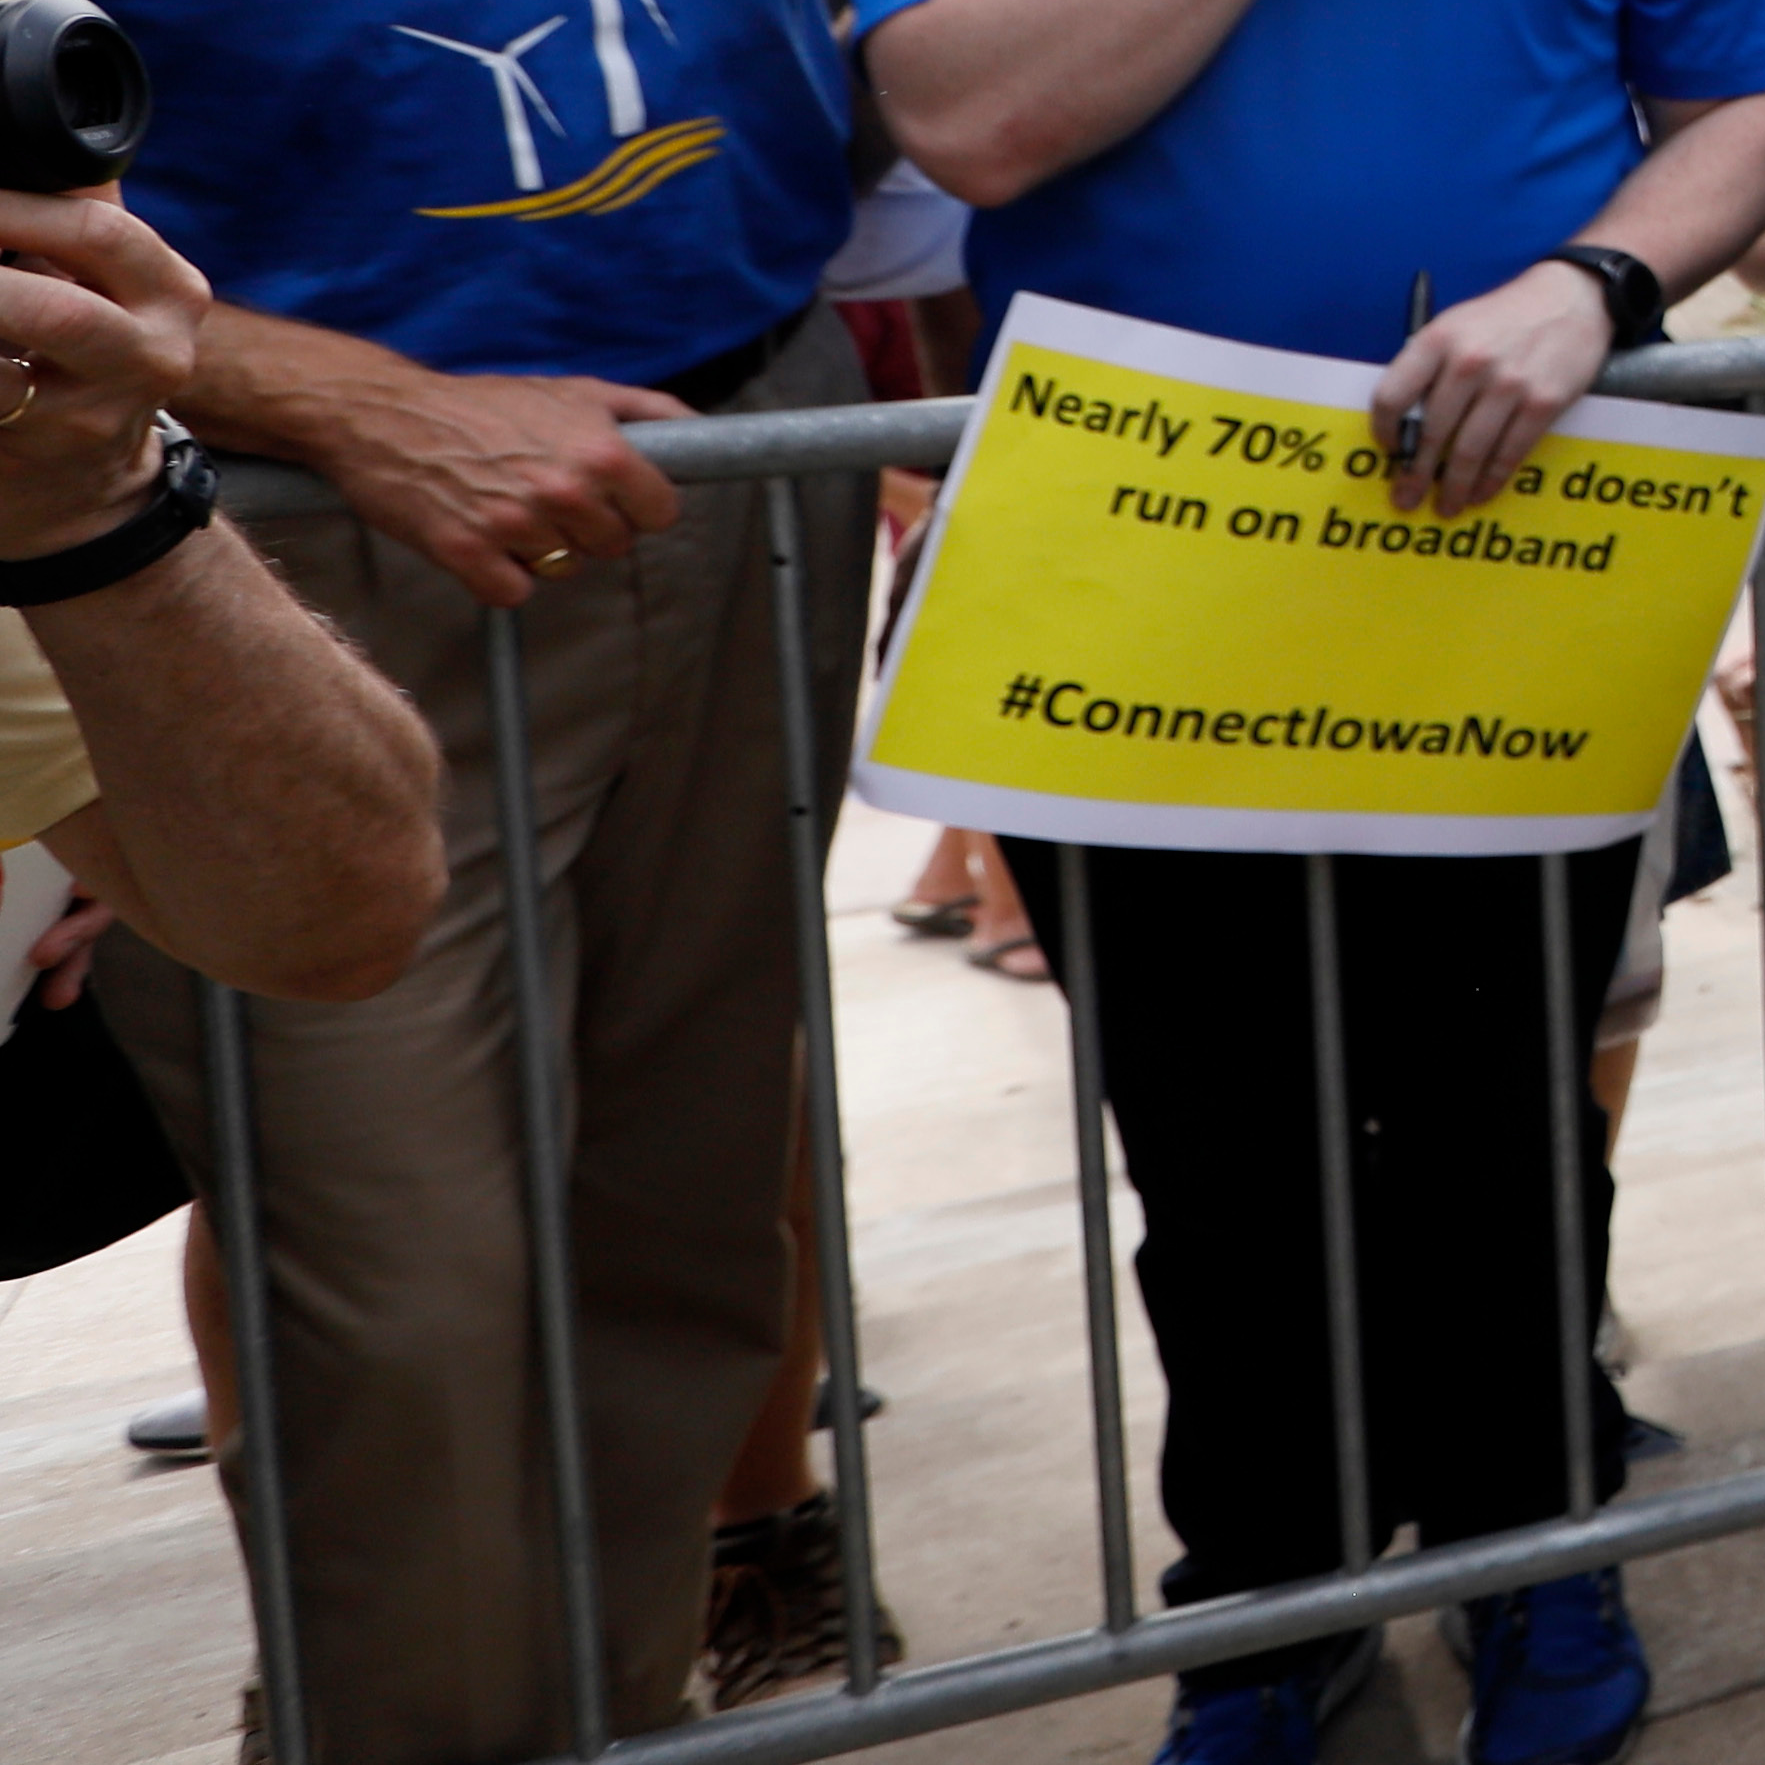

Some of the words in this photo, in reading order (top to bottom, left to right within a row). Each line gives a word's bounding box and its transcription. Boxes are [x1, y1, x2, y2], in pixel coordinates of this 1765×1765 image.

[1012, 372, 1190, 457] Nearly
[1209, 416, 1326, 473] 70%
[1559, 460, 1751, 519] doesn’t
[1111, 486, 1208, 530] run
[1228, 507, 1301, 543] on
[1319, 506, 1617, 573] broadband
[1001, 674, 1590, 760] #ConnectIowaNow
